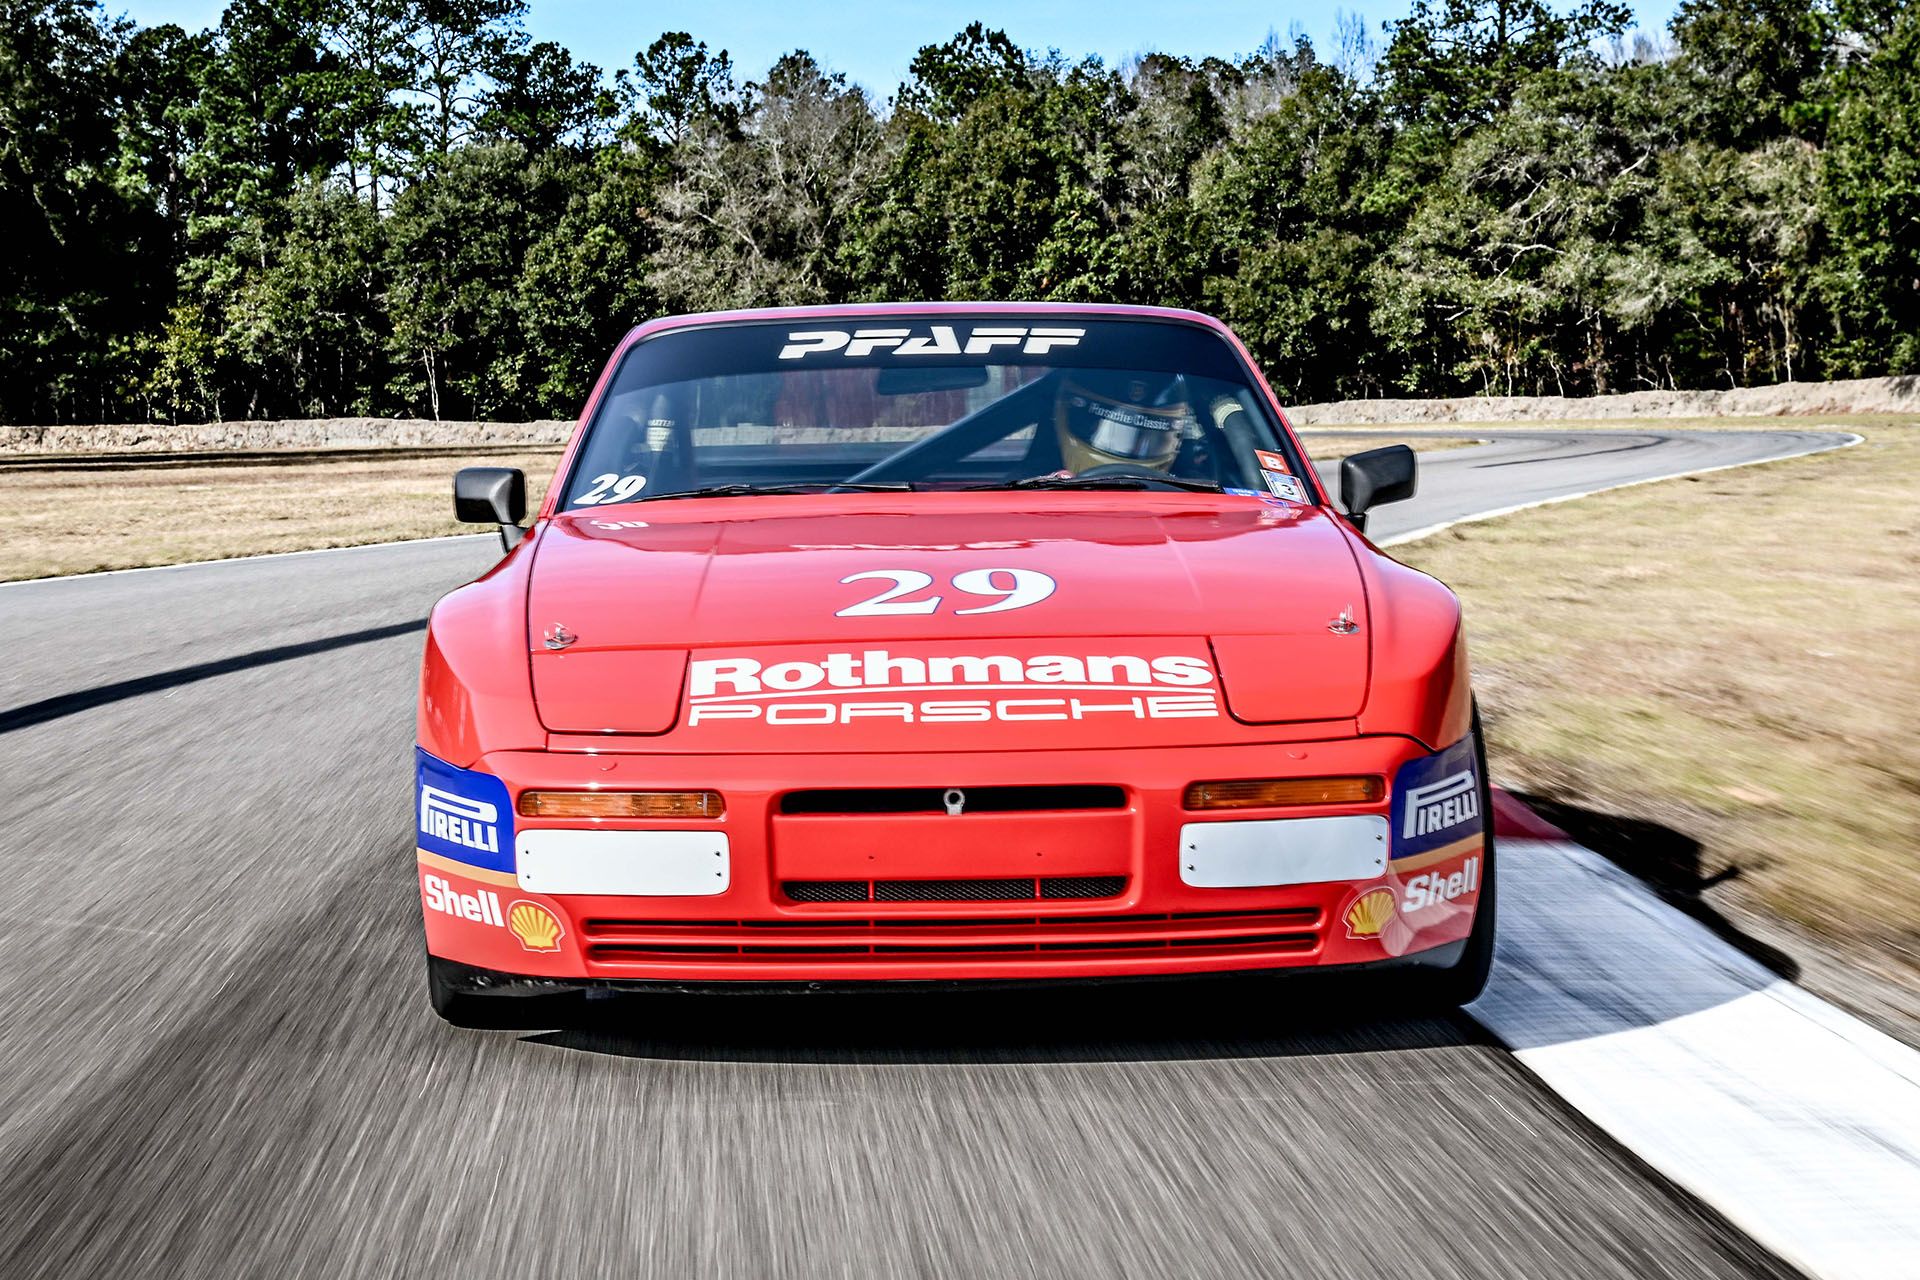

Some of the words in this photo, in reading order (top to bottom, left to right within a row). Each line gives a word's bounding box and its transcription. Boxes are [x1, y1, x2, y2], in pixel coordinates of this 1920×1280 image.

[778, 326, 1087, 360] PFAFF
[573, 473, 647, 505] 29
[834, 567, 1057, 617] 29
[689, 650, 1215, 697] Rothmans
[688, 695, 1220, 727] PORSCHE
[420, 784, 499, 853] PIRELLI
[1403, 769, 1478, 840] PIRELLI
[424, 873, 505, 928] Shell
[1402, 856, 1479, 913] Shell
